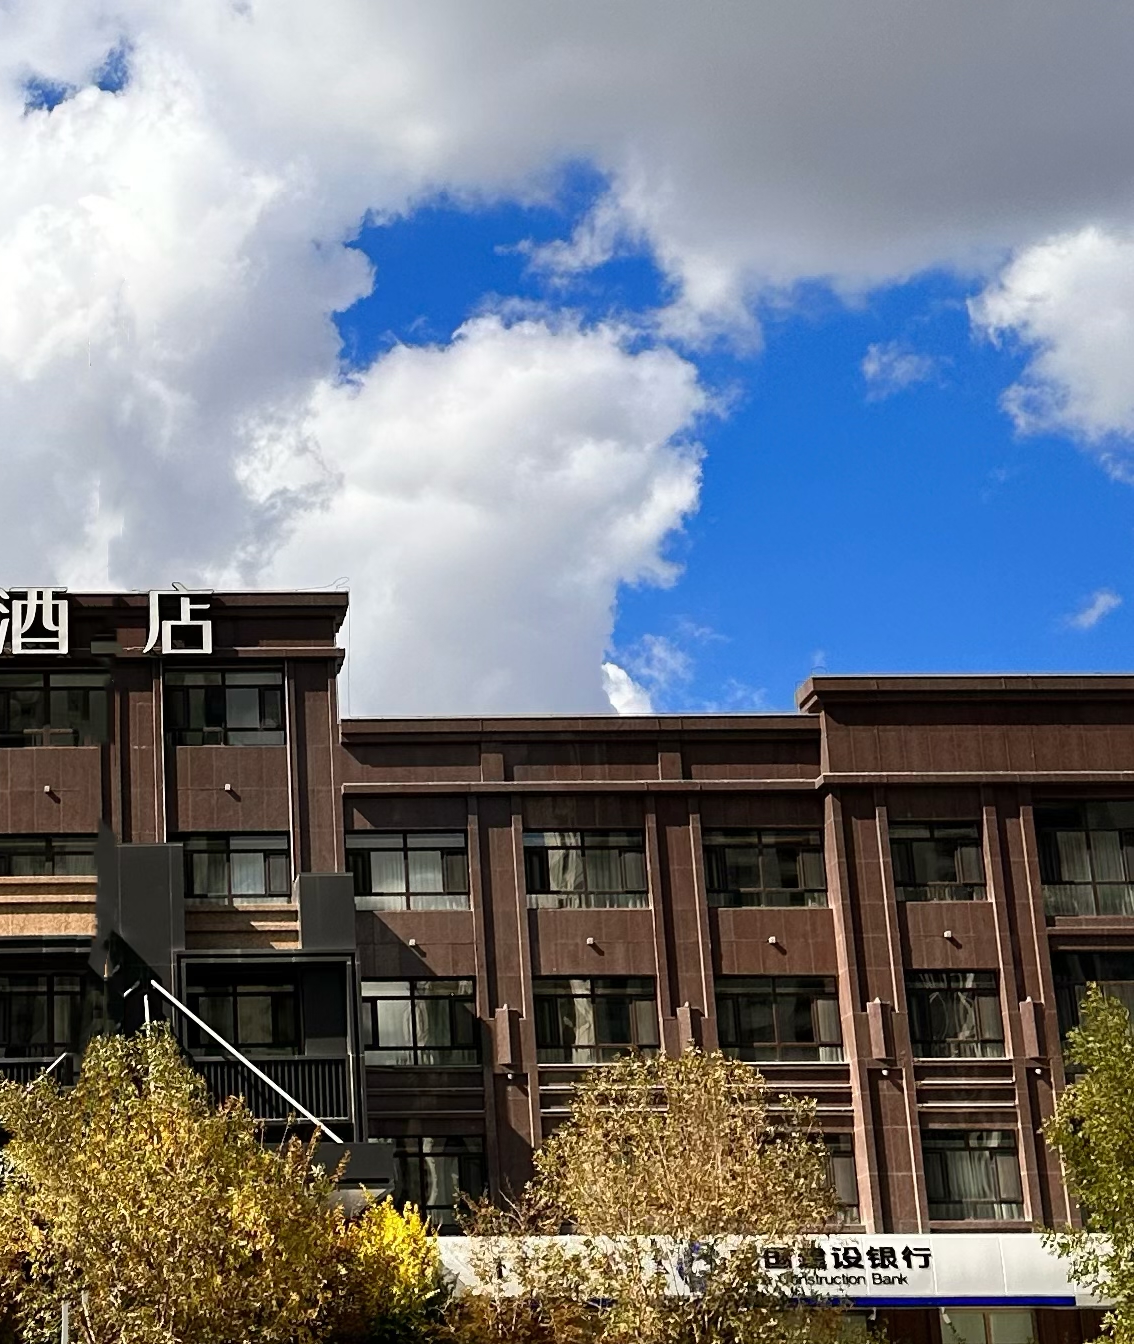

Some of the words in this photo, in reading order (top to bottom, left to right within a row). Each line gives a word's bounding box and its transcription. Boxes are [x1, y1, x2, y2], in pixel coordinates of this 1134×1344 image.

[731, 1245, 932, 1269] 国建设银行
[872, 1272, 909, 1286] Bank
